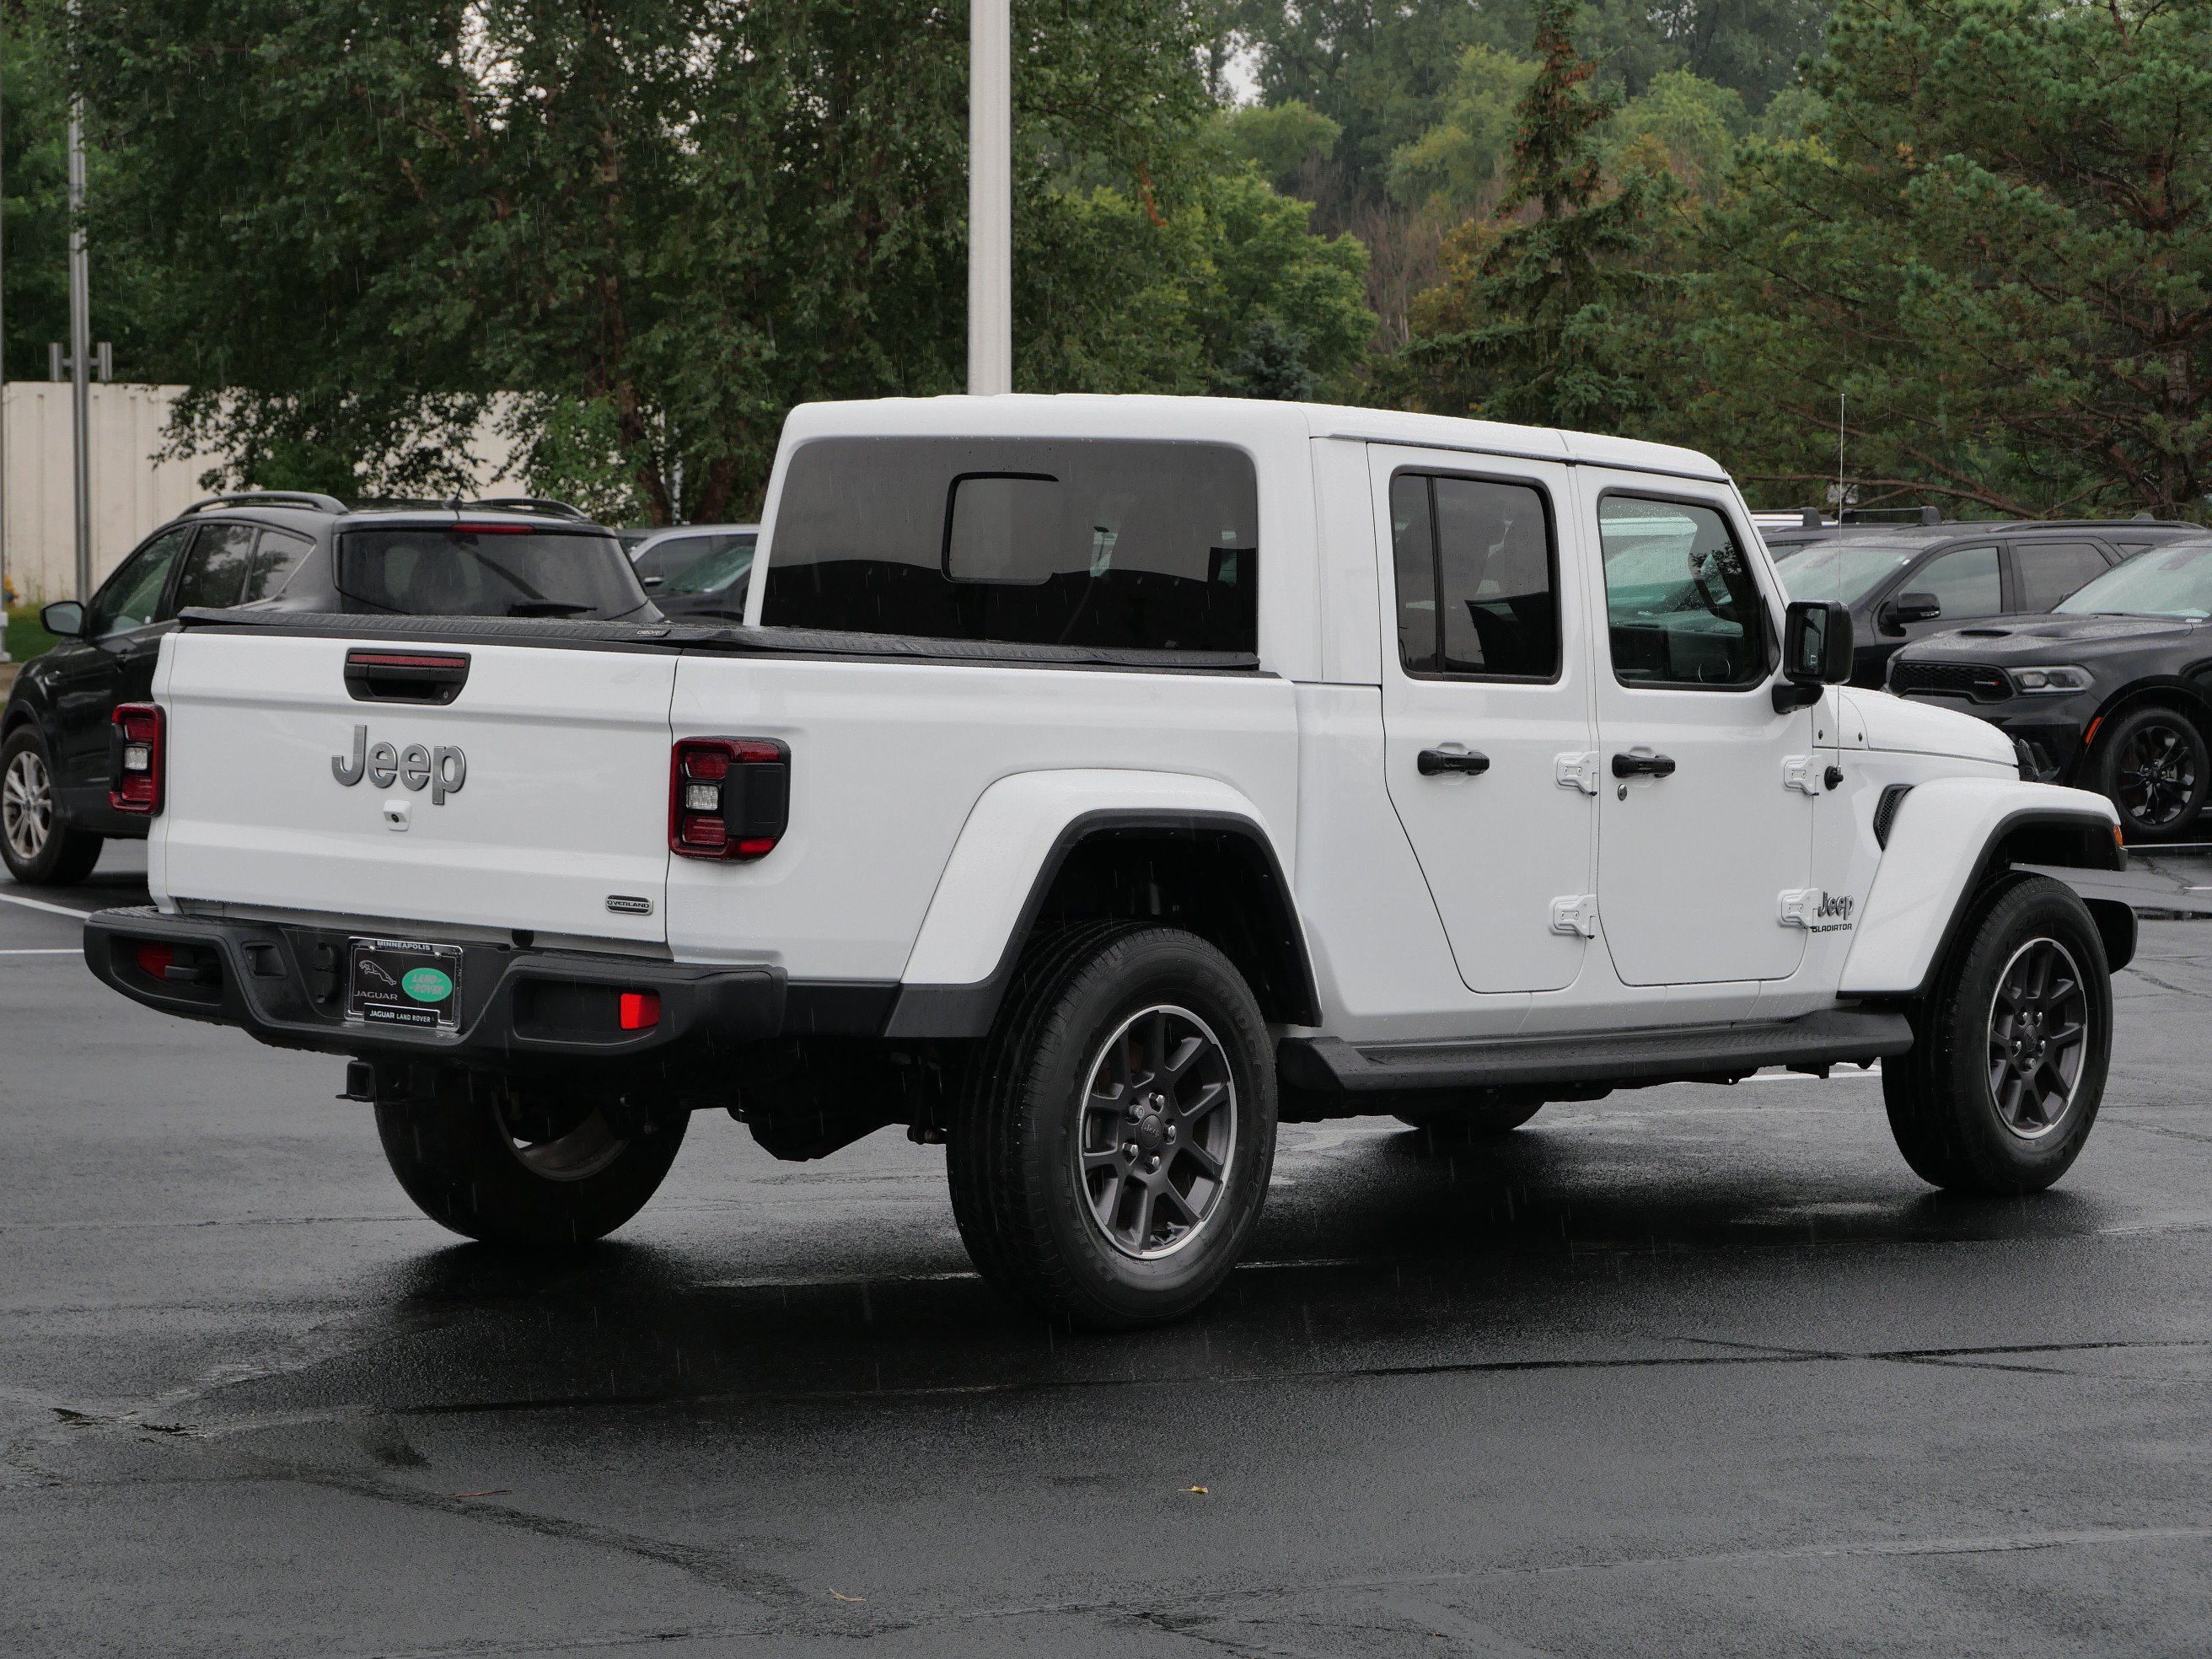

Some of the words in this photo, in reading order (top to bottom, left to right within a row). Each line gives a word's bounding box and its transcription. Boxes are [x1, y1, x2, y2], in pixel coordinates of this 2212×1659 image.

[331, 724, 466, 805] Jeep
[607, 899, 649, 909] OVERLAND
[1817, 891, 1854, 921] Jeep
[377, 940, 431, 951] MINNEAPOLIS
[354, 990, 398, 1001] JAGUAR
[369, 1010, 395, 1018] JAGUAR
